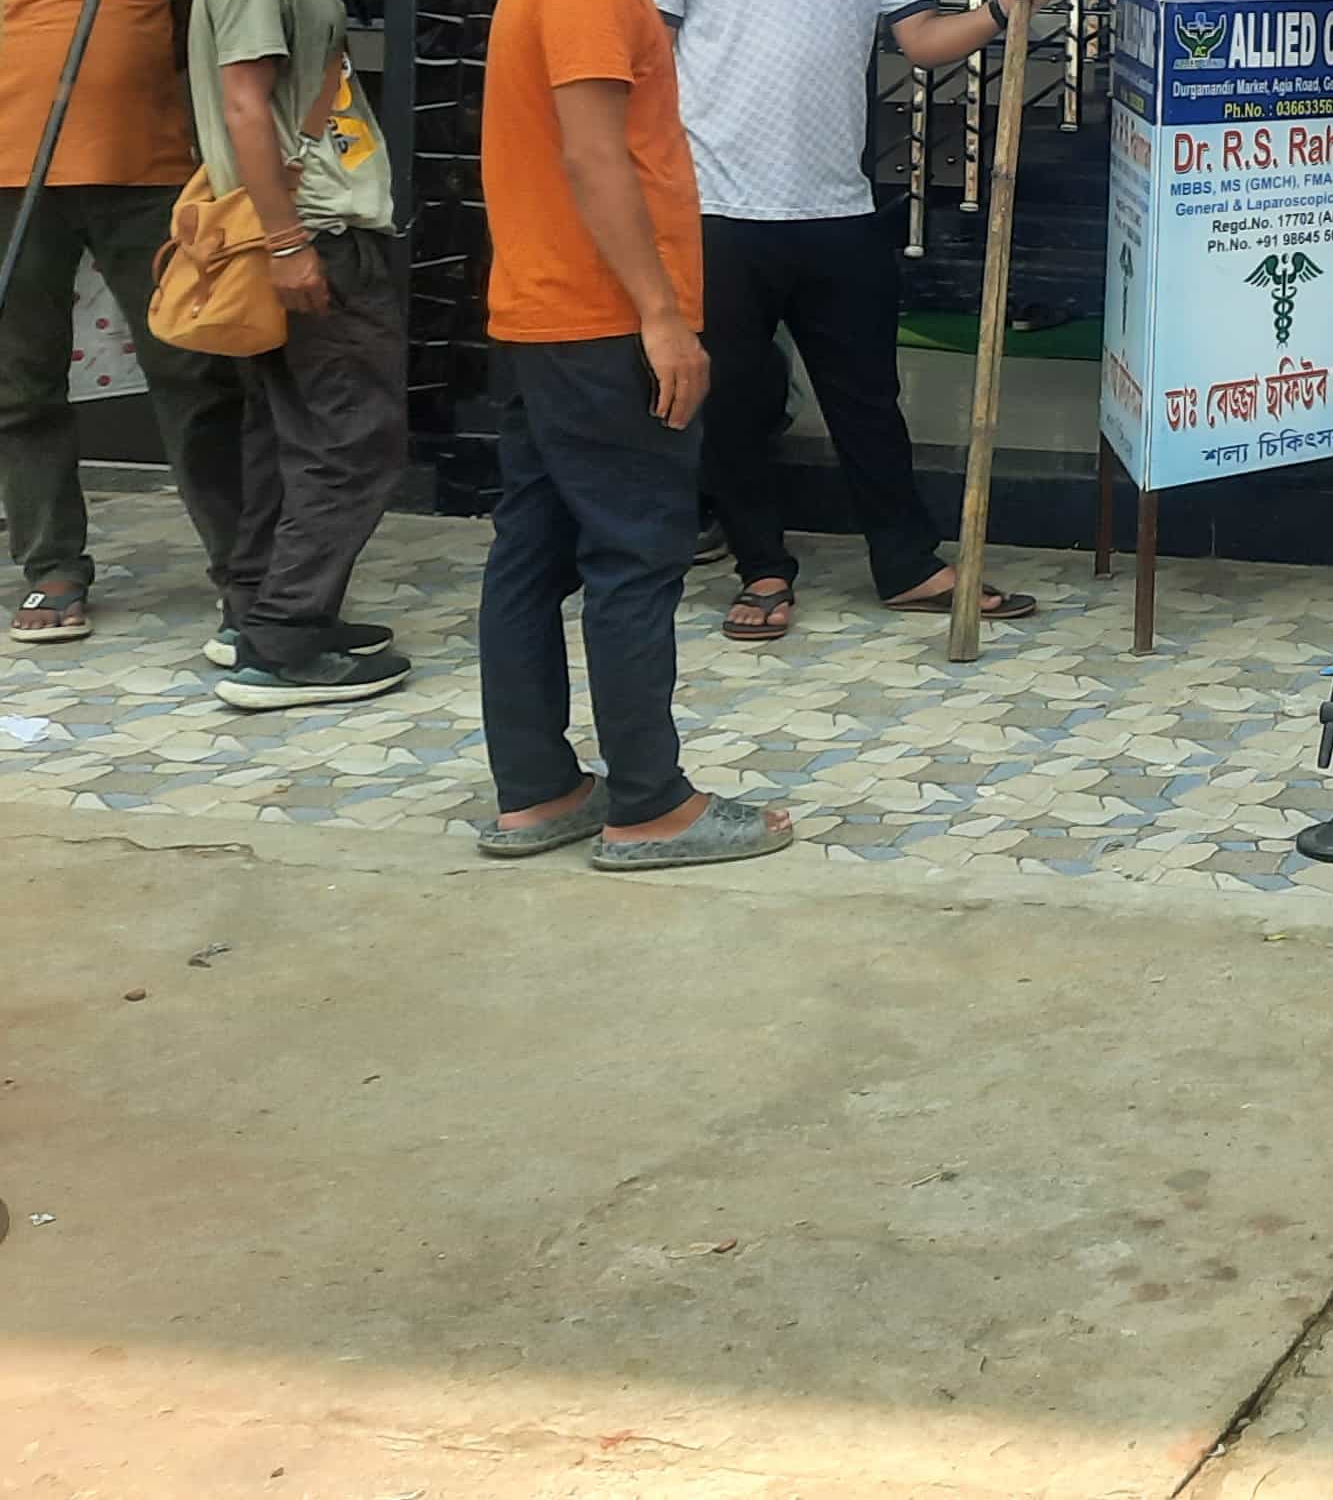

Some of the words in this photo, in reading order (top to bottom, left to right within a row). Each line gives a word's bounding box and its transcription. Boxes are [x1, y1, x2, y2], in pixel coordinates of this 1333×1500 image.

[1228, 10, 1317, 69] ALLIED
[1172, 80, 1236, 100] Durgamandir
[1272, 78, 1294, 98] Agia
[1294, 76, 1321, 94] Road,
[1174, 132, 1213, 175] Dr.
[1222, 127, 1280, 171] R.S.
[1170, 180, 1217, 197] MBBS,
[1220, 179, 1242, 194] MS
[1175, 199, 1229, 217] General
[1232, 199, 1243, 212] &
[1277, 211, 1315, 228] 17702
[1255, 234, 1278, 249] +91
[1200, 443, 1250, 467] শল্য
